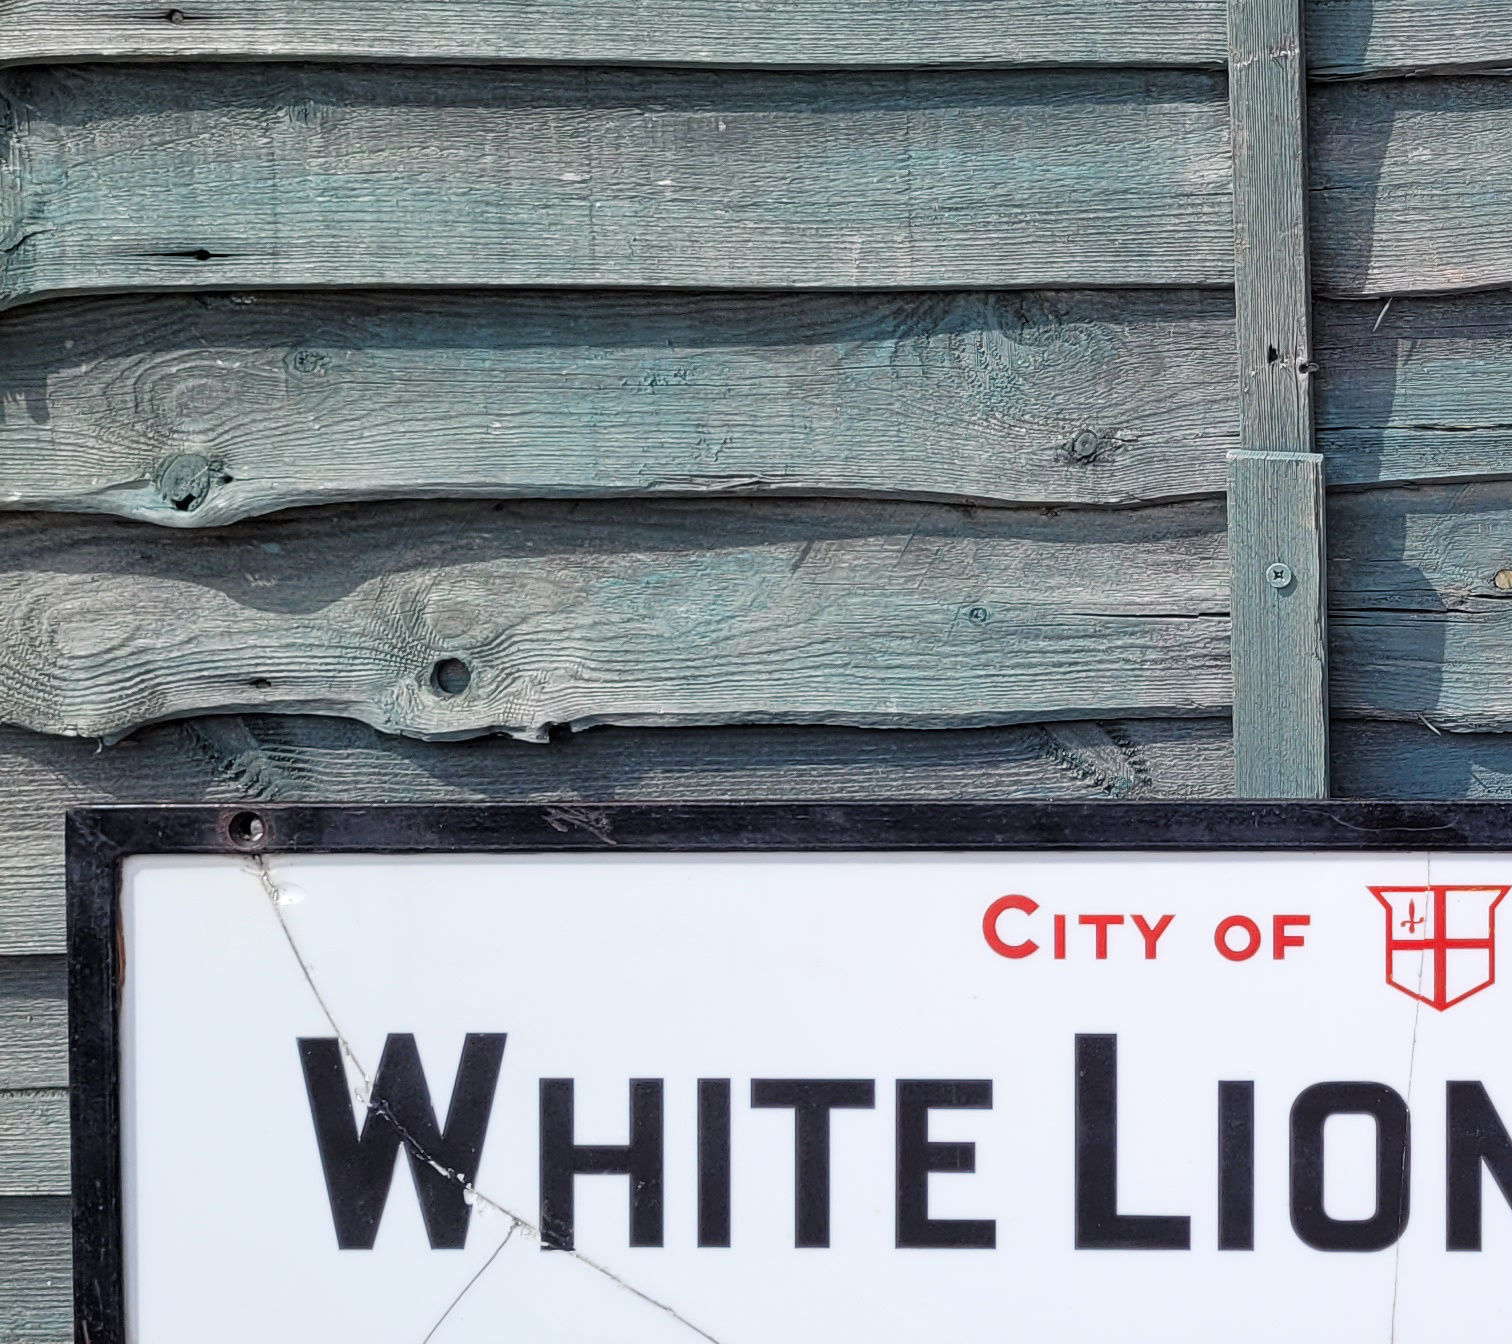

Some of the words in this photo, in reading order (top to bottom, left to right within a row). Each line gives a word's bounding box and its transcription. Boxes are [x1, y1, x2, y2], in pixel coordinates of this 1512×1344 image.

[982, 894, 1175, 962] CITY
[1214, 914, 1311, 963] OF
[298, 1032, 997, 1253] WHITE
